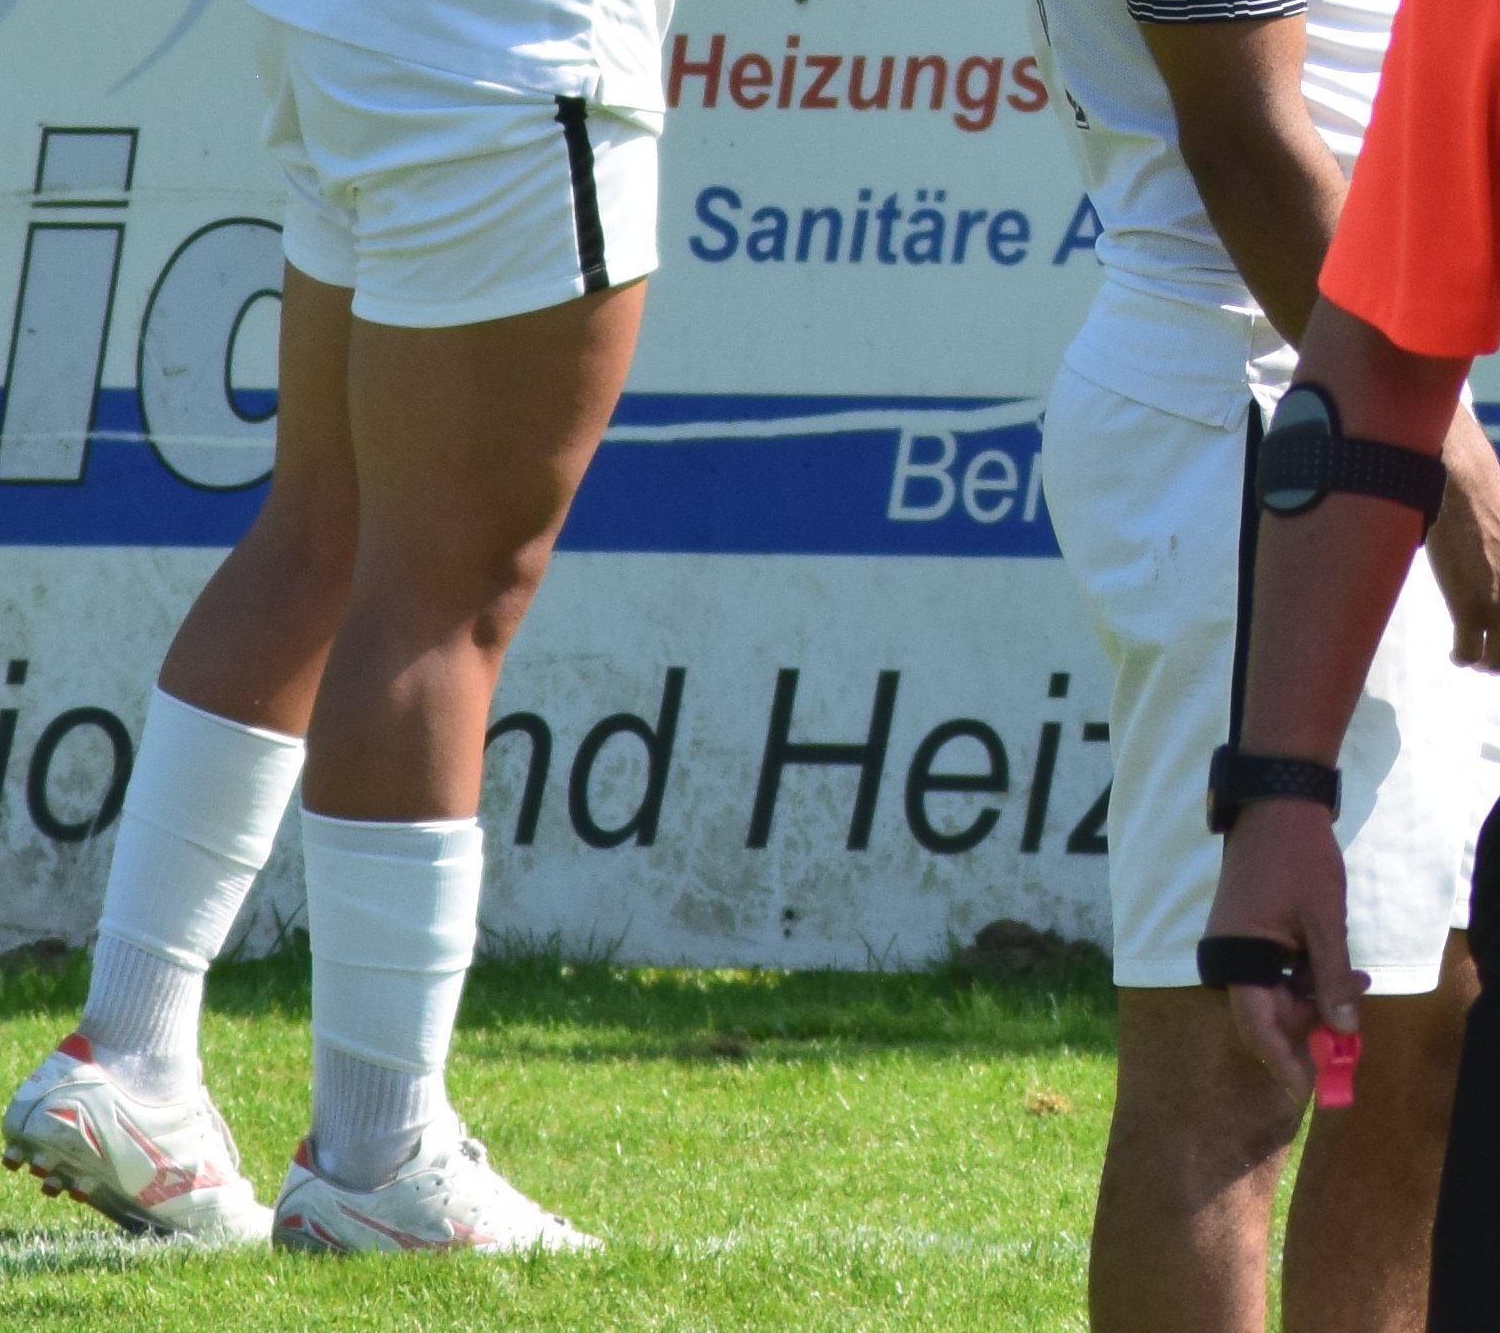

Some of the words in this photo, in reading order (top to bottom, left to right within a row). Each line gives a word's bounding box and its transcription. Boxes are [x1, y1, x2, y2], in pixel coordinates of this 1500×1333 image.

[667, 35, 1050, 131] Heizungs
[689, 186, 1030, 265] Sanitäre
[483, 666, 687, 849] nd
[745, 668, 1115, 854] Heiz
